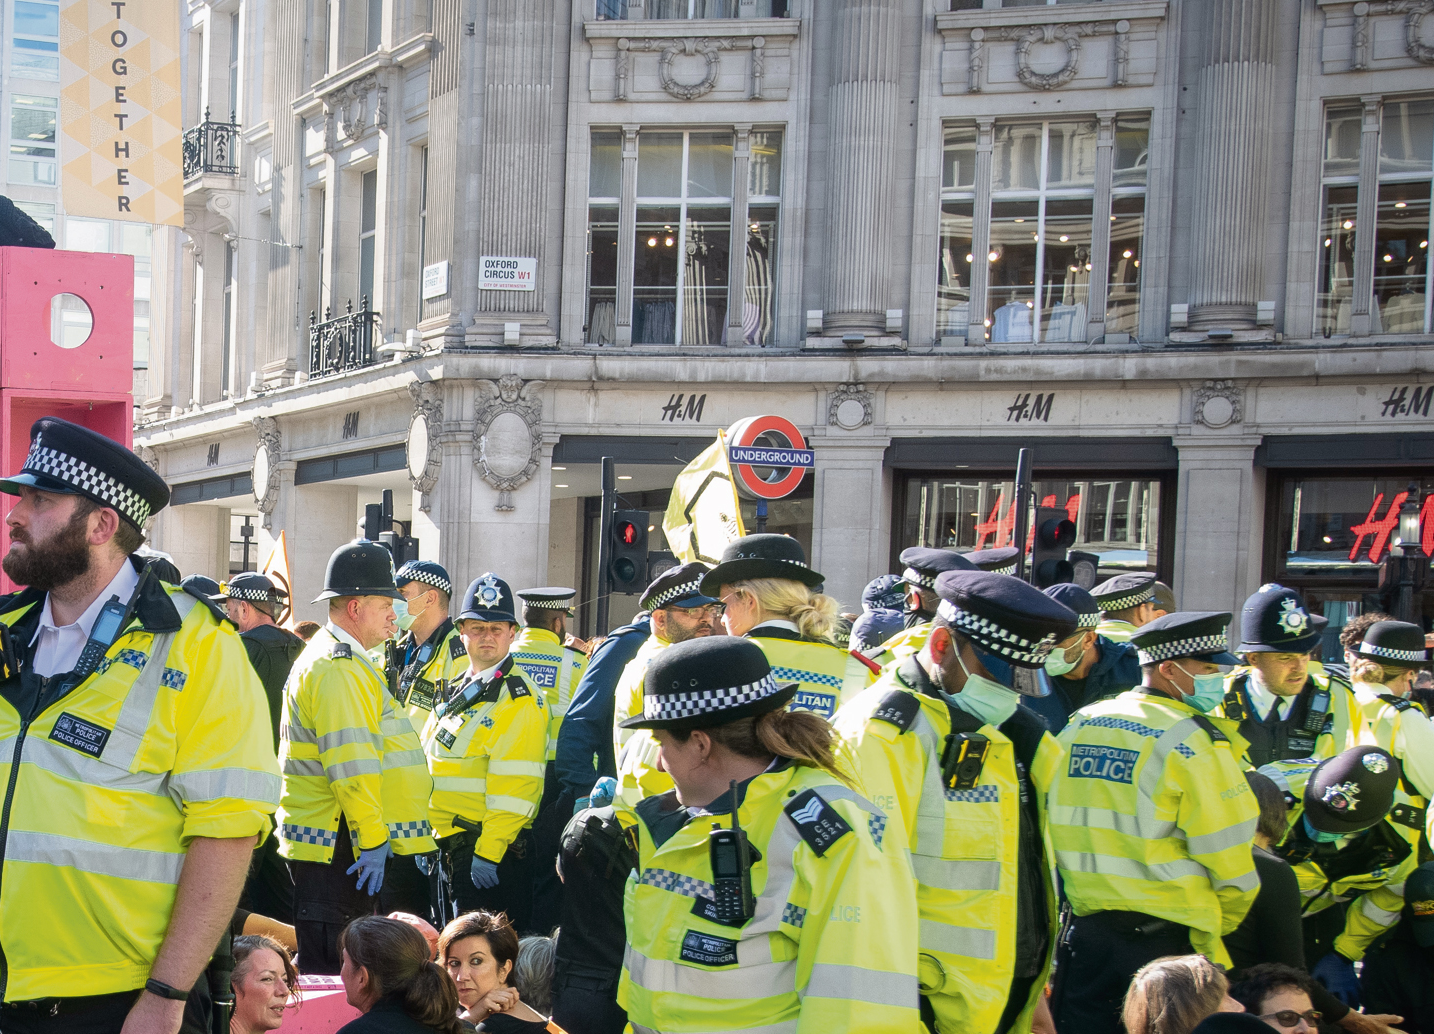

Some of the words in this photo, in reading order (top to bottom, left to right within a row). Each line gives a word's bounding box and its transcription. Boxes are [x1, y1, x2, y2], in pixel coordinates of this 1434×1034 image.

[110, 2, 131, 212] TOGETHER
[484, 259, 518, 269] OXFORD
[484, 270, 515, 280] CIRCUS
[517, 271, 531, 280] W1
[661, 393, 707, 423] H&M
[1006, 392, 1055, 423] H&M
[1381, 385, 1434, 418] H&M
[732, 449, 811, 464] UNDERGROUND
[530, 673, 555, 687] ICE
[53, 730, 75, 744] POLICE
[74, 738, 99, 753] OFFICER
[74, 729, 97, 741] POLICE
[1069, 756, 1133, 781] POLICE
[829, 905, 861, 923] LICE
[682, 949, 705, 961] POLICE
[704, 953, 734, 963] OFFICER
